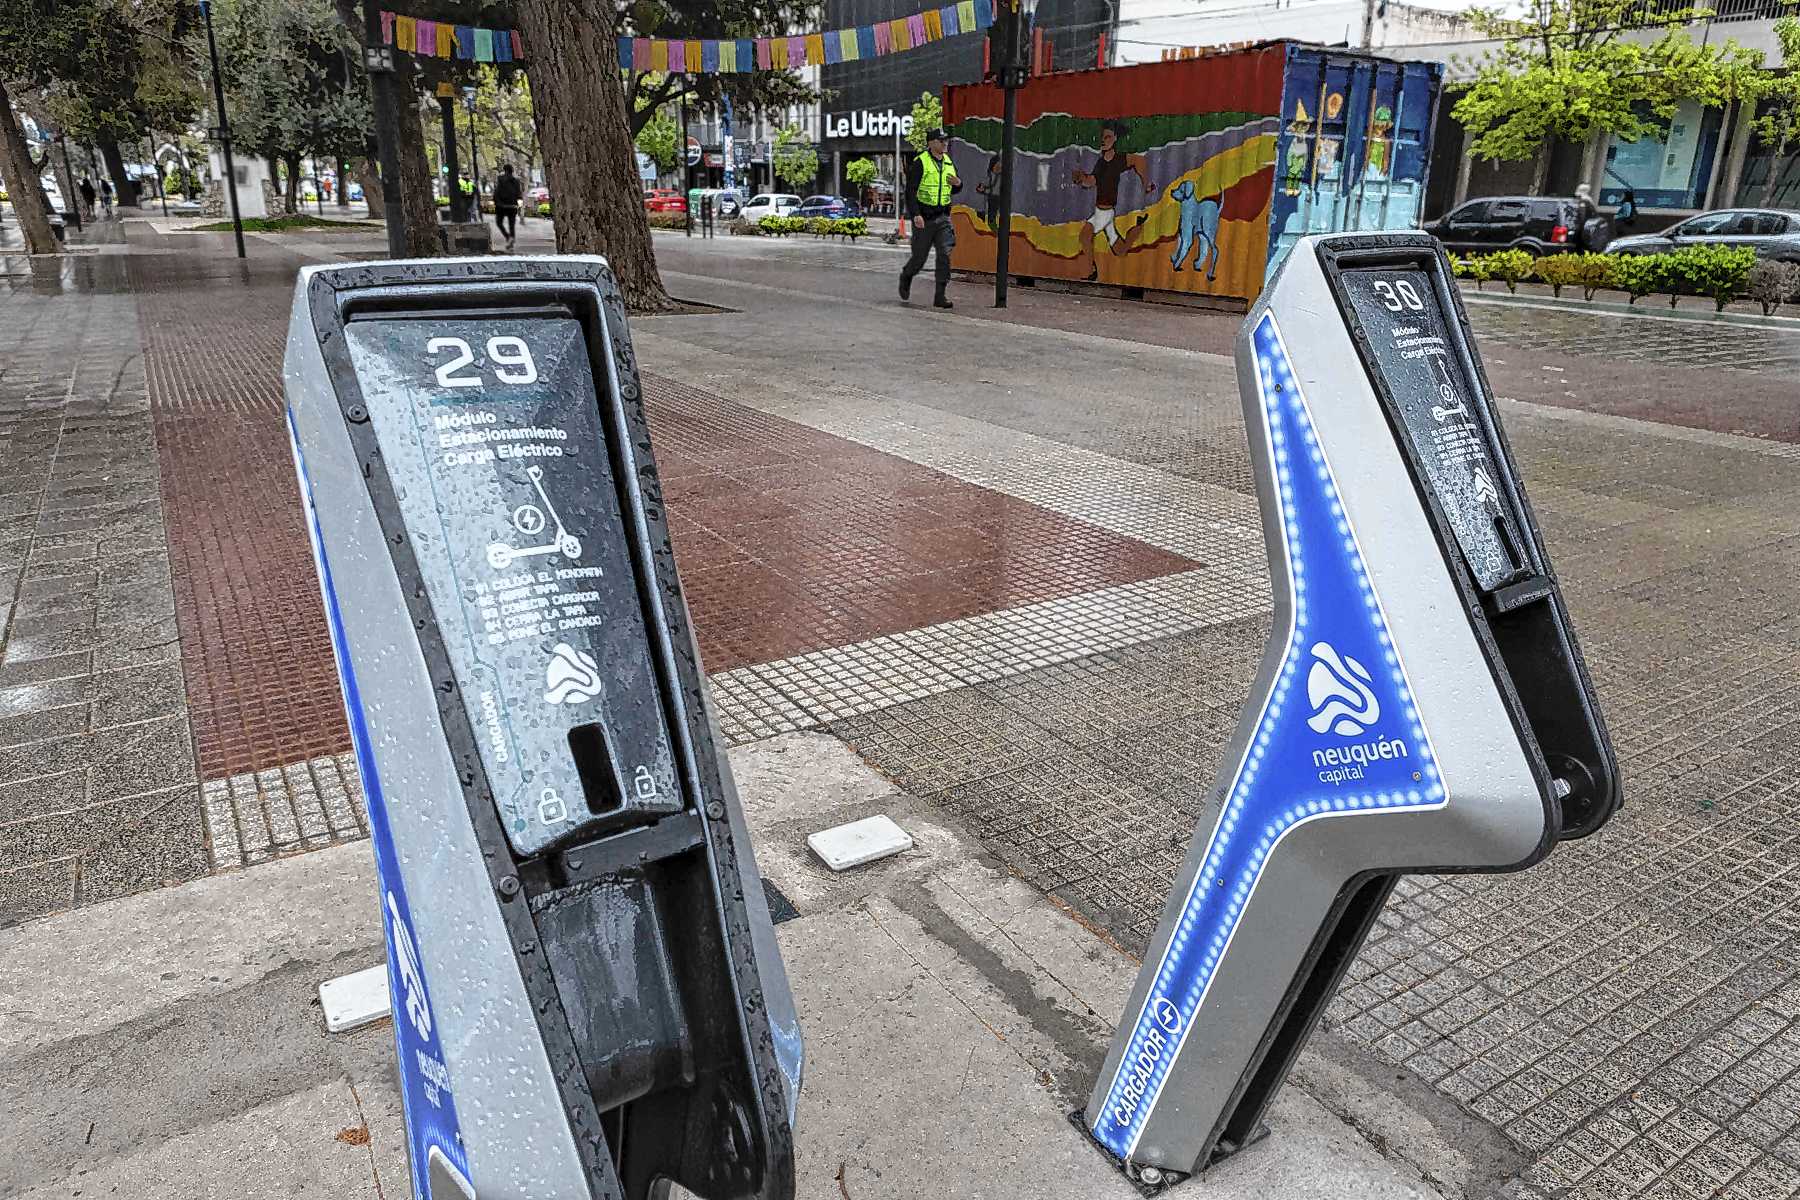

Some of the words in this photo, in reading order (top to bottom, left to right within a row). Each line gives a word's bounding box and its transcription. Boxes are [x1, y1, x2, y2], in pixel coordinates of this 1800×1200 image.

[1374, 280, 1423, 312] 30
[427, 336, 538, 388] 29
[434, 411, 497, 430] Módulo
[438, 426, 568, 448] Estacionamiento
[444, 448, 495, 466] Carga
[497, 442, 564, 459] Eléctrico
[537, 571, 554, 582] EL
[552, 591, 600, 605] CARGADOR
[543, 609, 560, 620] LA
[1312, 734, 1408, 767] neuquén
[1318, 765, 1364, 786] capital
[1114, 1027, 1167, 1127] CARGADOR
